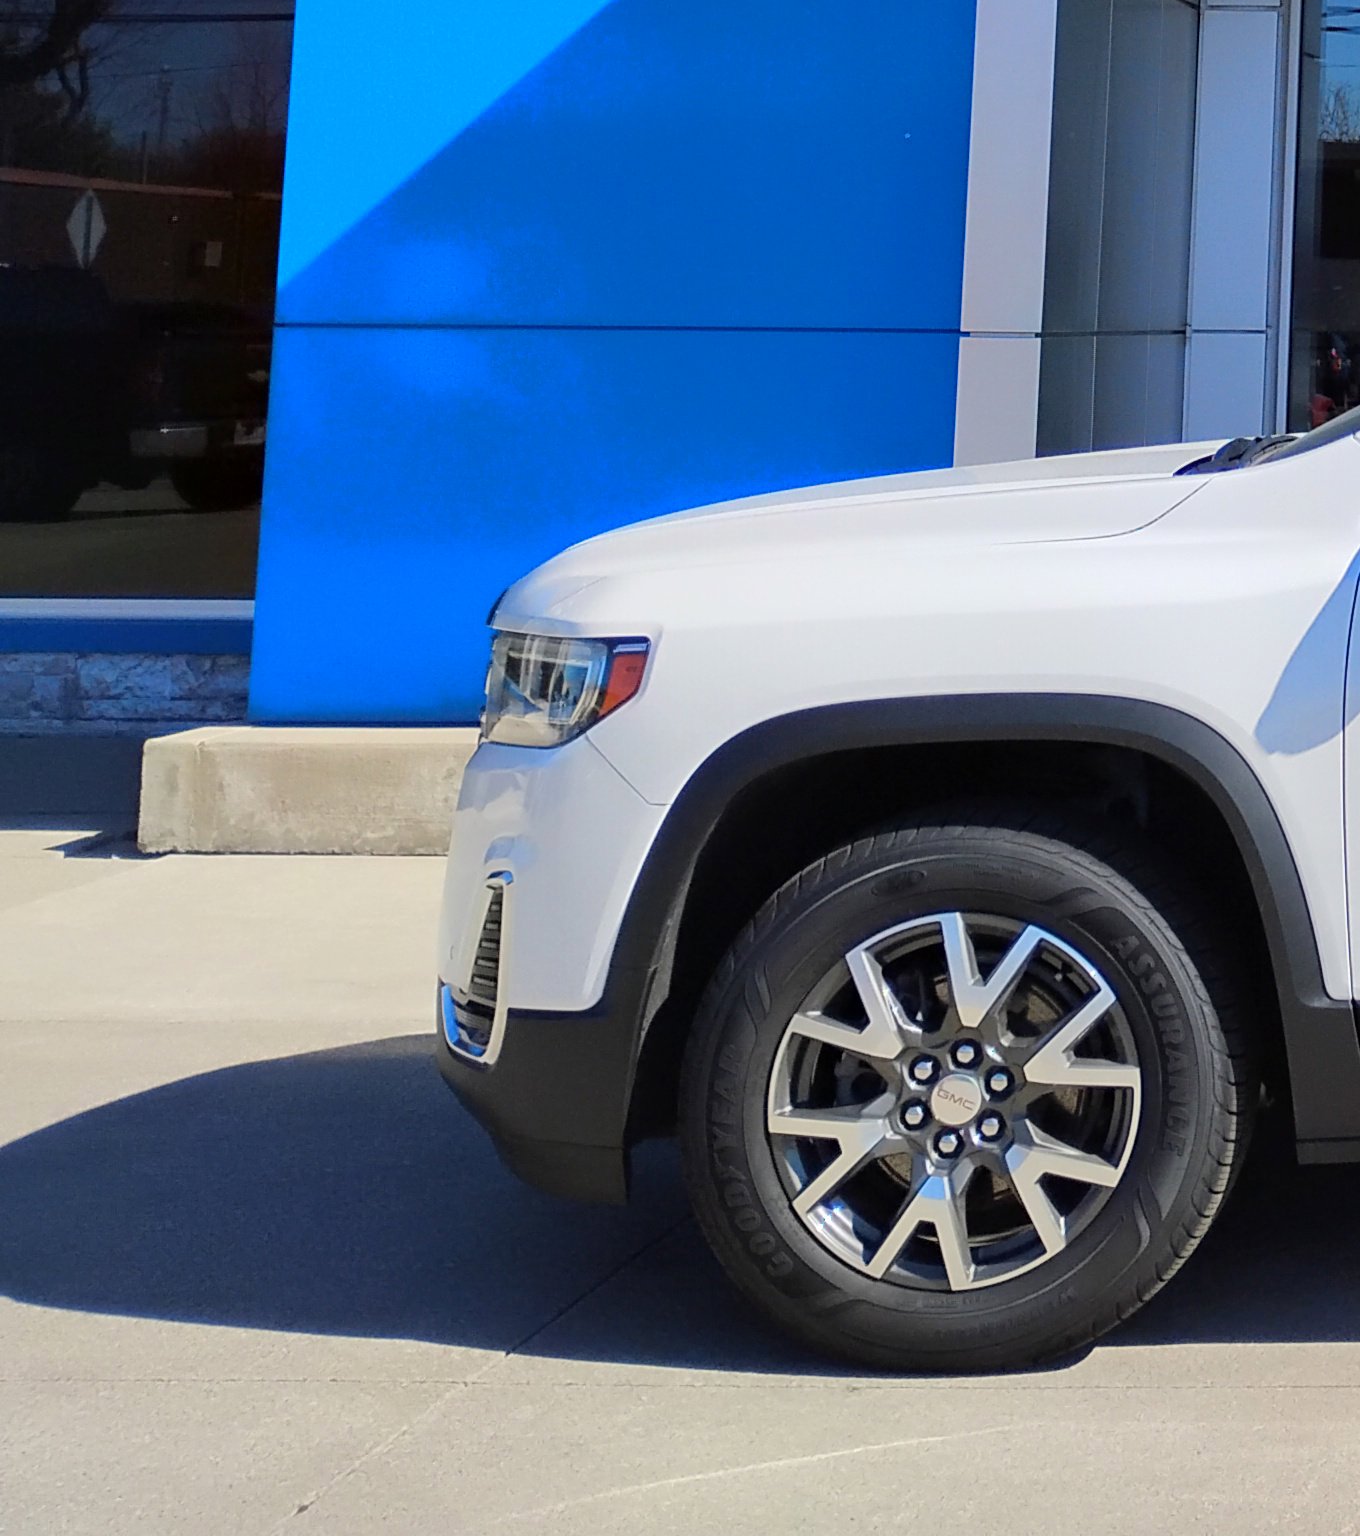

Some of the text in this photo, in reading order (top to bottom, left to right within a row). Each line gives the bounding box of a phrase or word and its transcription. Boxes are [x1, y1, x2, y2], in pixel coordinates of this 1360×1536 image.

[937, 1087, 976, 1112] GMC
[1112, 935, 1190, 1158] ASSURANCE
[709, 1044, 794, 1277] GOODYEAR
